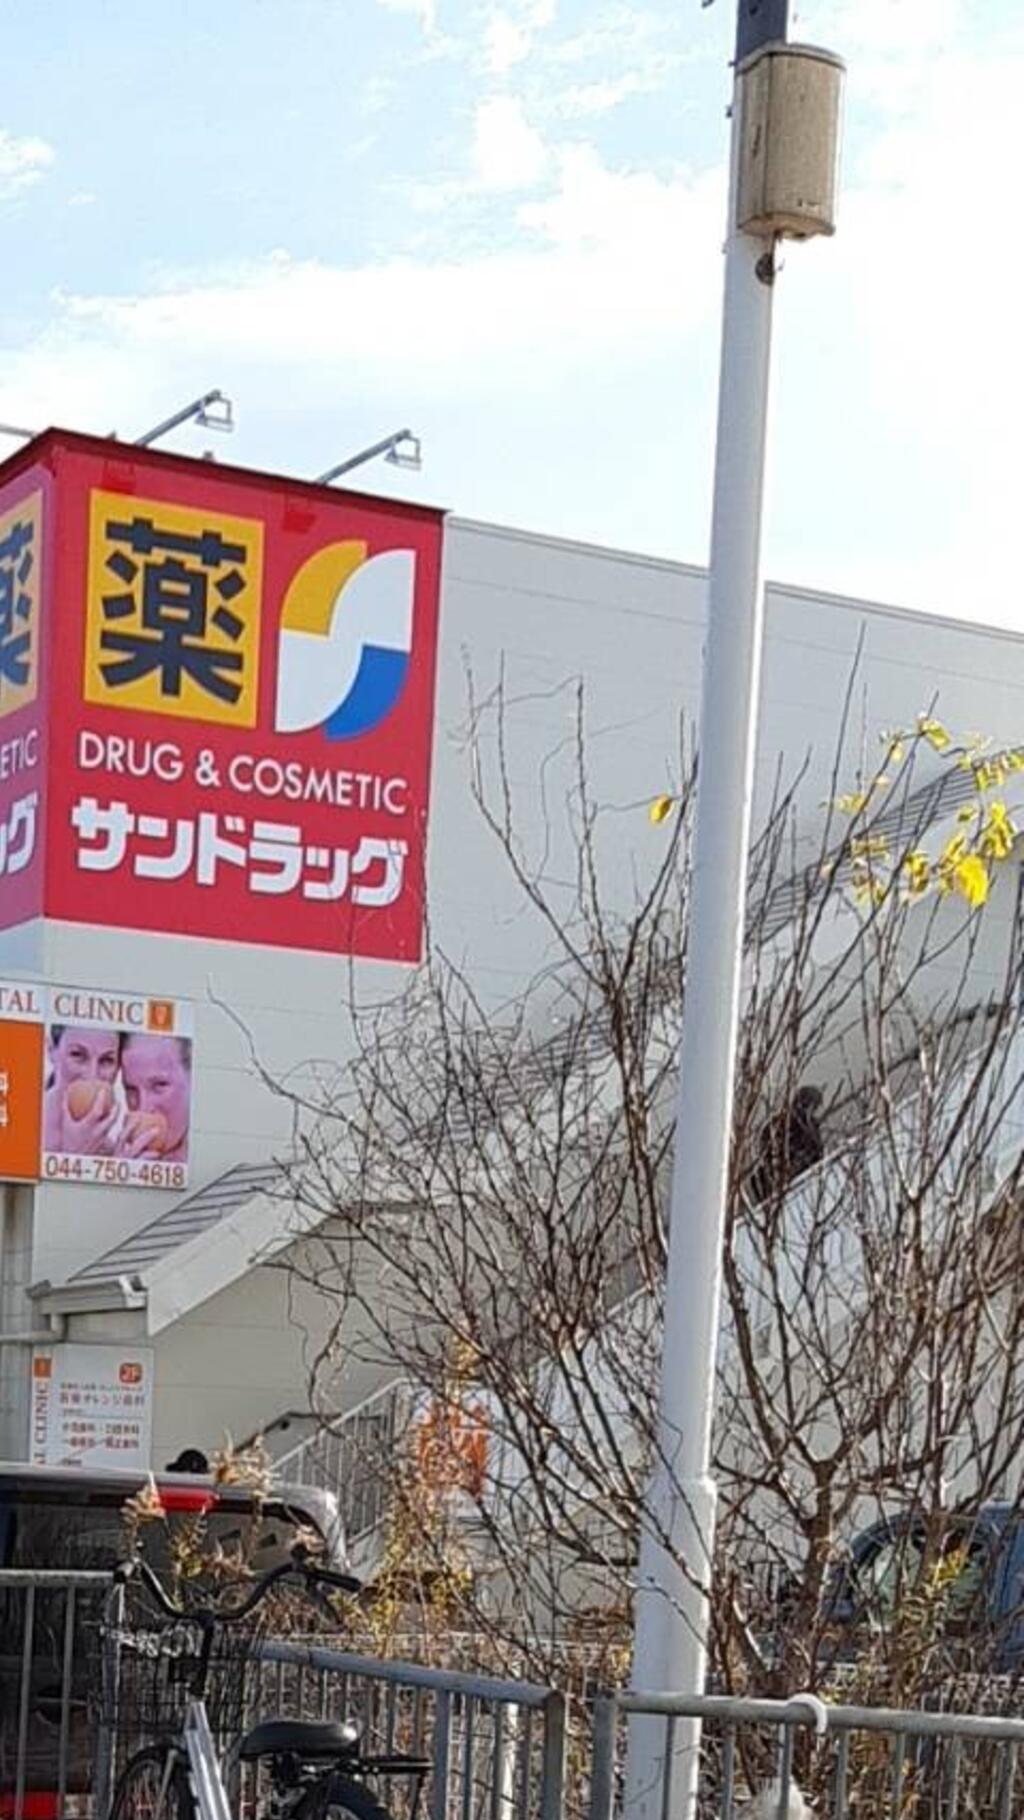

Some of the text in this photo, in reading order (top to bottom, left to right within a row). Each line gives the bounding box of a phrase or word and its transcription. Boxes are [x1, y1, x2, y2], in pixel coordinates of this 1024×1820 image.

[98, 516, 248, 705] 薬
[78, 730, 409, 814] DRUG & COSMETIC
[70, 796, 409, 907] サンドラッグ
[53, 993, 145, 1026] CLINIC
[44, 1155, 186, 1187] 044-750-4618
